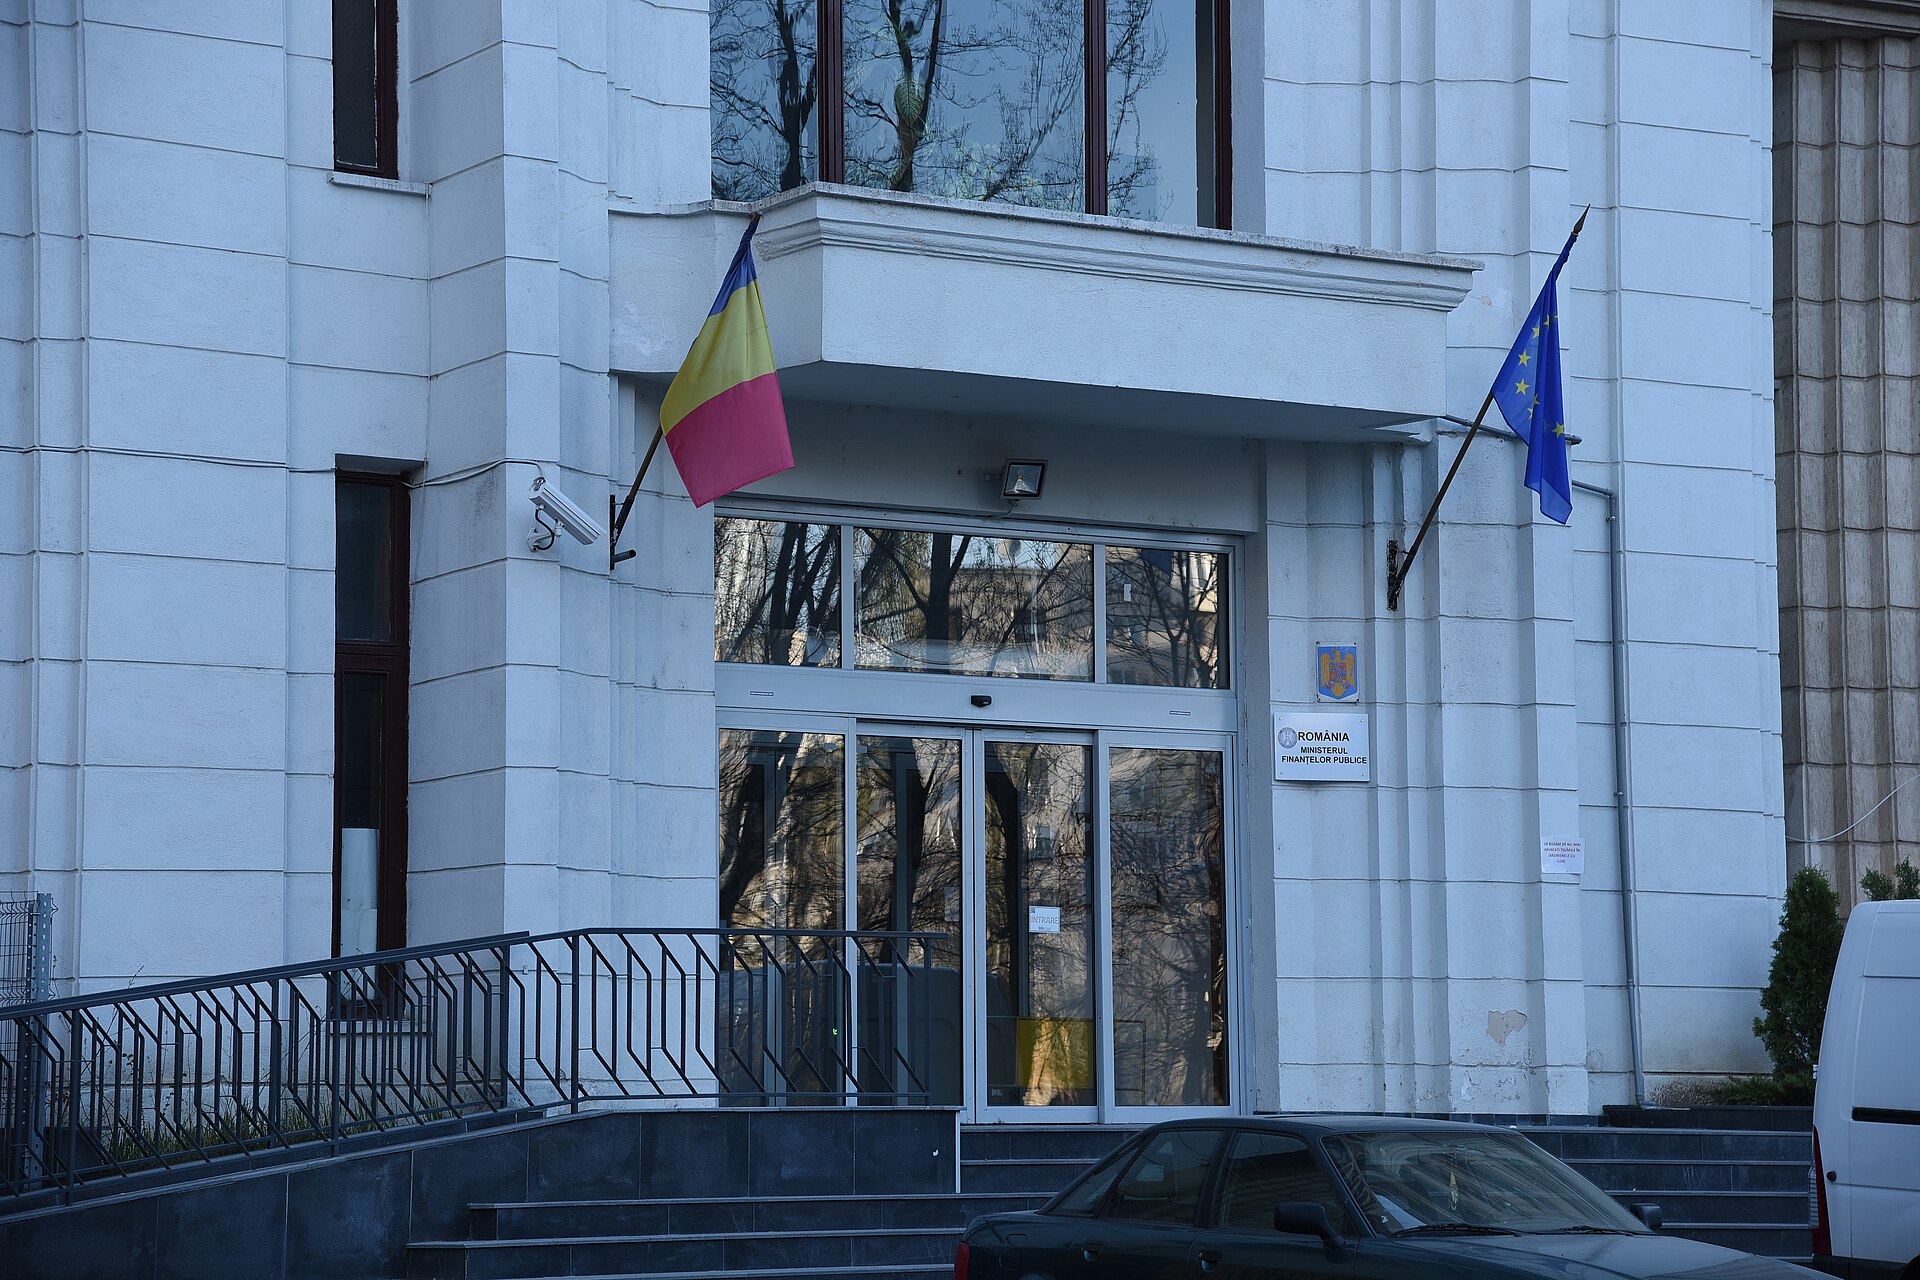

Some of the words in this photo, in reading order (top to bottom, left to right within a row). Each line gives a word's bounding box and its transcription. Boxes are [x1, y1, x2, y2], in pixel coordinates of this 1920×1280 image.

[1298, 730, 1350, 742] ROMÂNIA
[1300, 746, 1348, 754] MINISTERUL
[1333, 756, 1367, 764] PUBLICE
